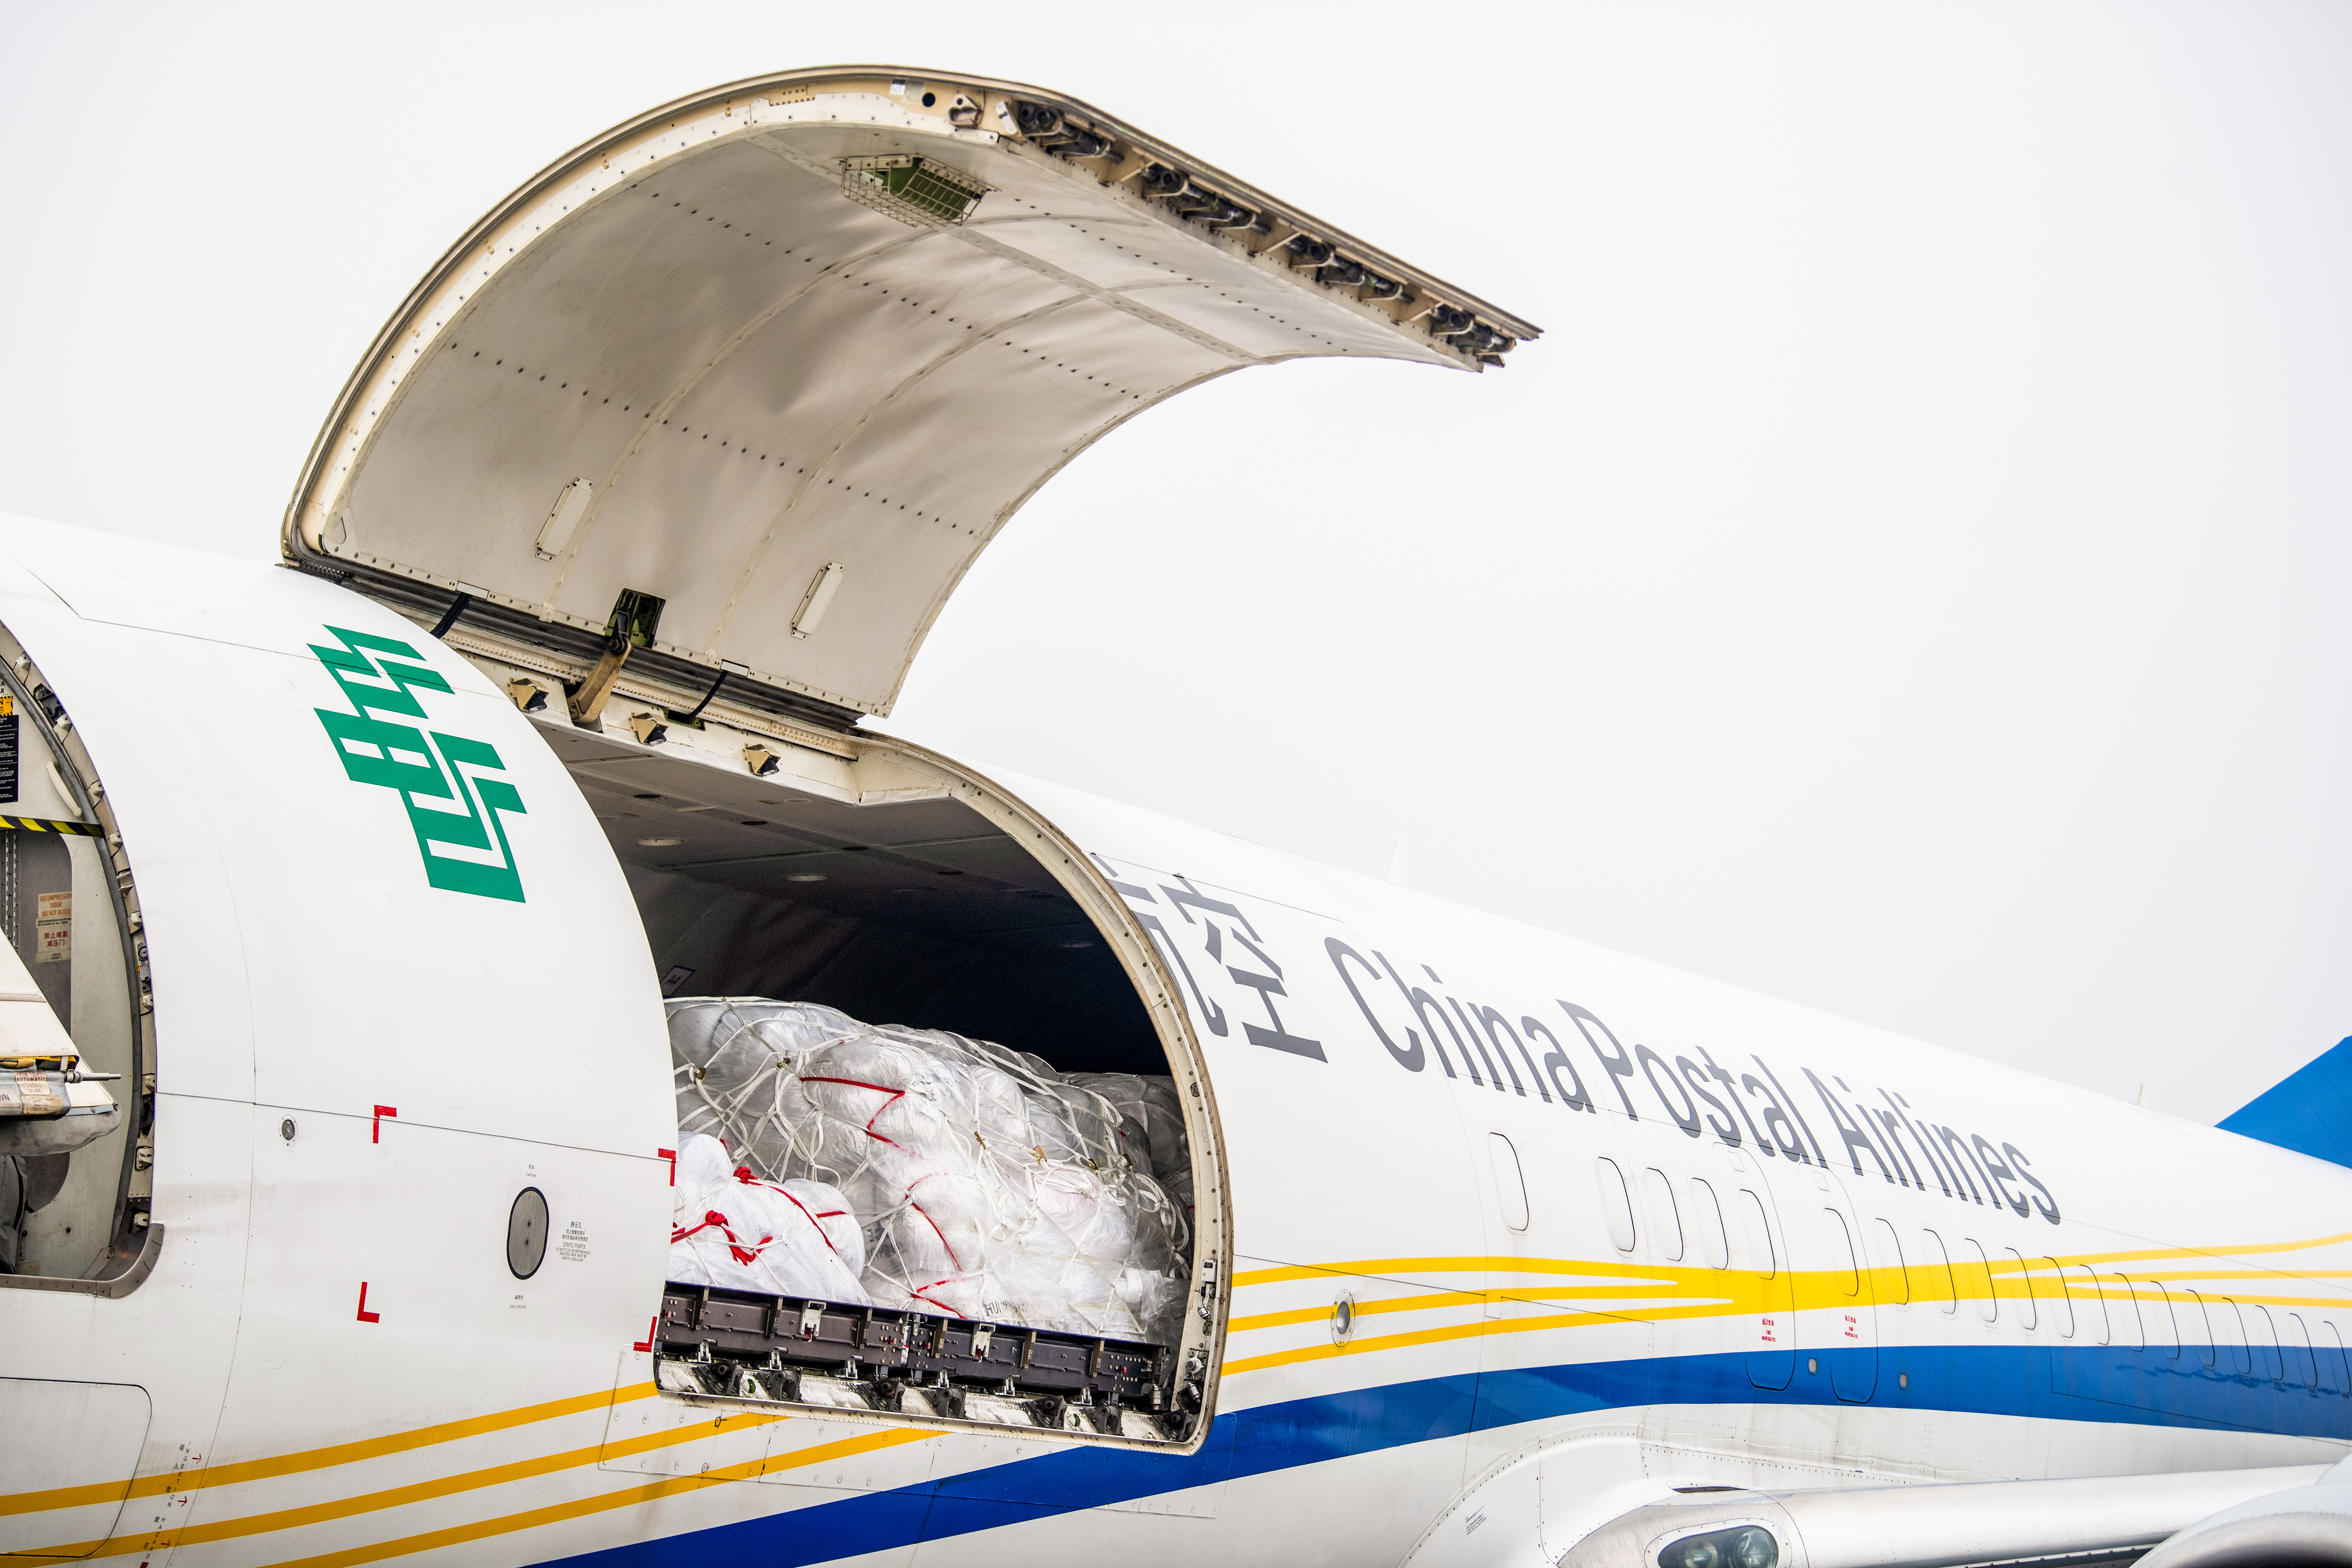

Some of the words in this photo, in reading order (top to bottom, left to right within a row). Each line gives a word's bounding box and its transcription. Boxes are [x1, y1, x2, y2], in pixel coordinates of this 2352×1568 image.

[40, 893, 72, 901] DECOMPRESSION
[44, 931, 68, 939] 禁止堵塞
[47, 939, 65, 947] 减压门
[1324, 937, 1596, 1114] China
[1556, 999, 1828, 1169] Postal
[1800, 1067, 2061, 1225] Airlines
[167, 1441, 191, 1507] INGESTION
[146, 1517, 166, 1559] HAZARD
